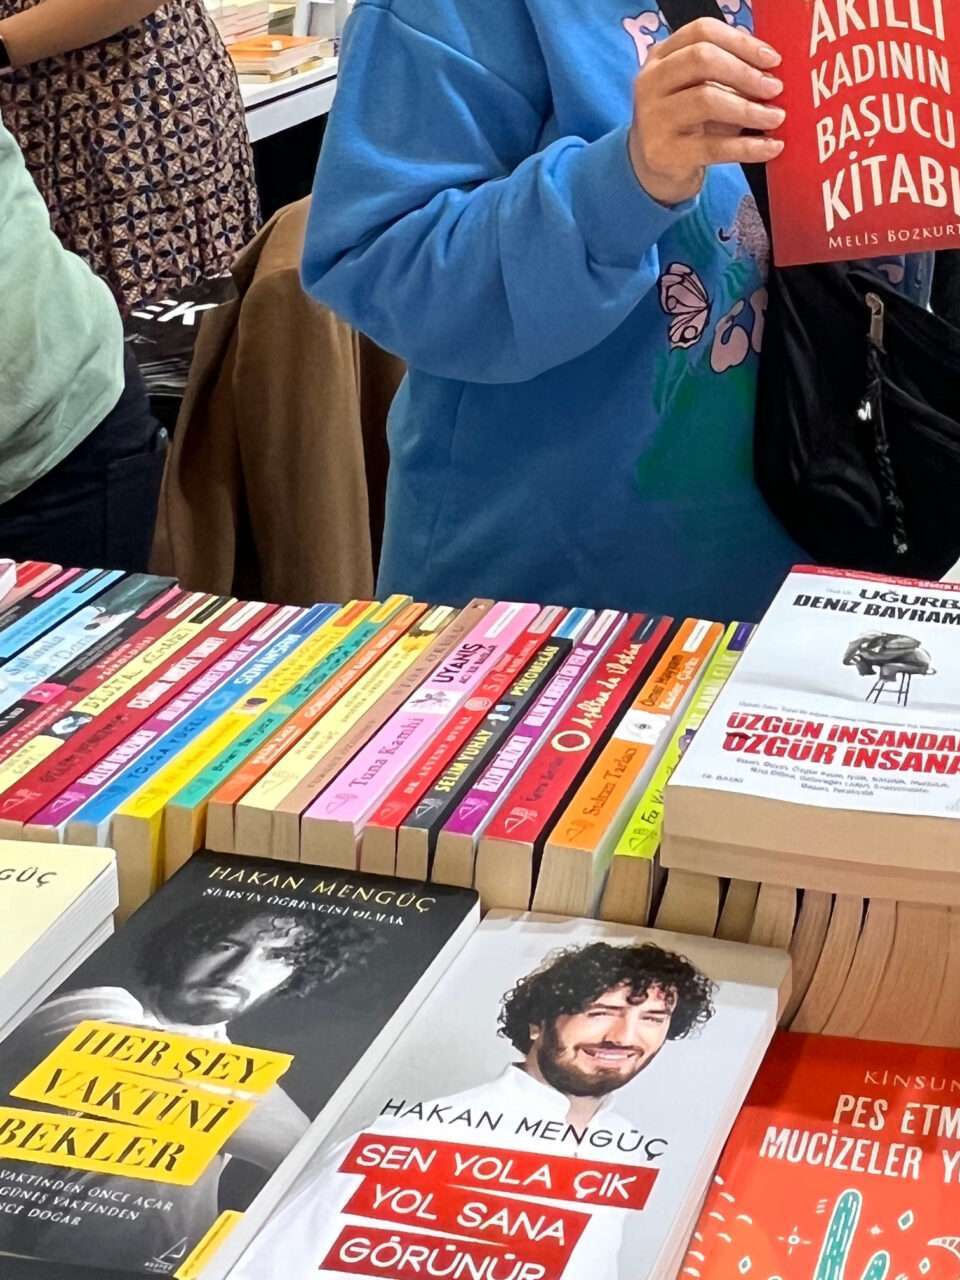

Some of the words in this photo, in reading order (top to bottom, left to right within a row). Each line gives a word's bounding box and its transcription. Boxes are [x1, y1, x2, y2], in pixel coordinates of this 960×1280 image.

[810, 40, 951, 108] KADININ
[815, 93, 956, 163] BAŞUCU
[828, 231, 878, 249] MELİS
[793, 594, 861, 614] DENİZ
[432, 643, 485, 684] UYANIŞ
[461, 728, 494, 766] YUHAY
[726, 711, 824, 740] ÜZGÜN
[349, 754, 389, 788] Tuna
[208, 865, 304, 891] HAKAN
[311, 880, 437, 914] MENGÜÇ
[72, 1028, 172, 1067] HER
[174, 1047, 272, 1086] ŞEY
[40, 1068, 235, 1133] VAKTİNİ
[833, 1095, 888, 1132] PES
[0, 1117, 186, 1173] BEKLER
[380, 1098, 503, 1131] HAKAN
[514, 1118, 669, 1161] MENGÜÇ
[760, 1125, 922, 1180] MUCİZELER
[355, 1143, 438, 1172] SEN
[452, 1153, 552, 1191] YOLA
[573, 1171, 640, 1202] ÇIK
[371, 1184, 440, 1221] YOL
[456, 1202, 569, 1246] SANA
[339, 1236, 547, 1280] GÖRÜNÜR
